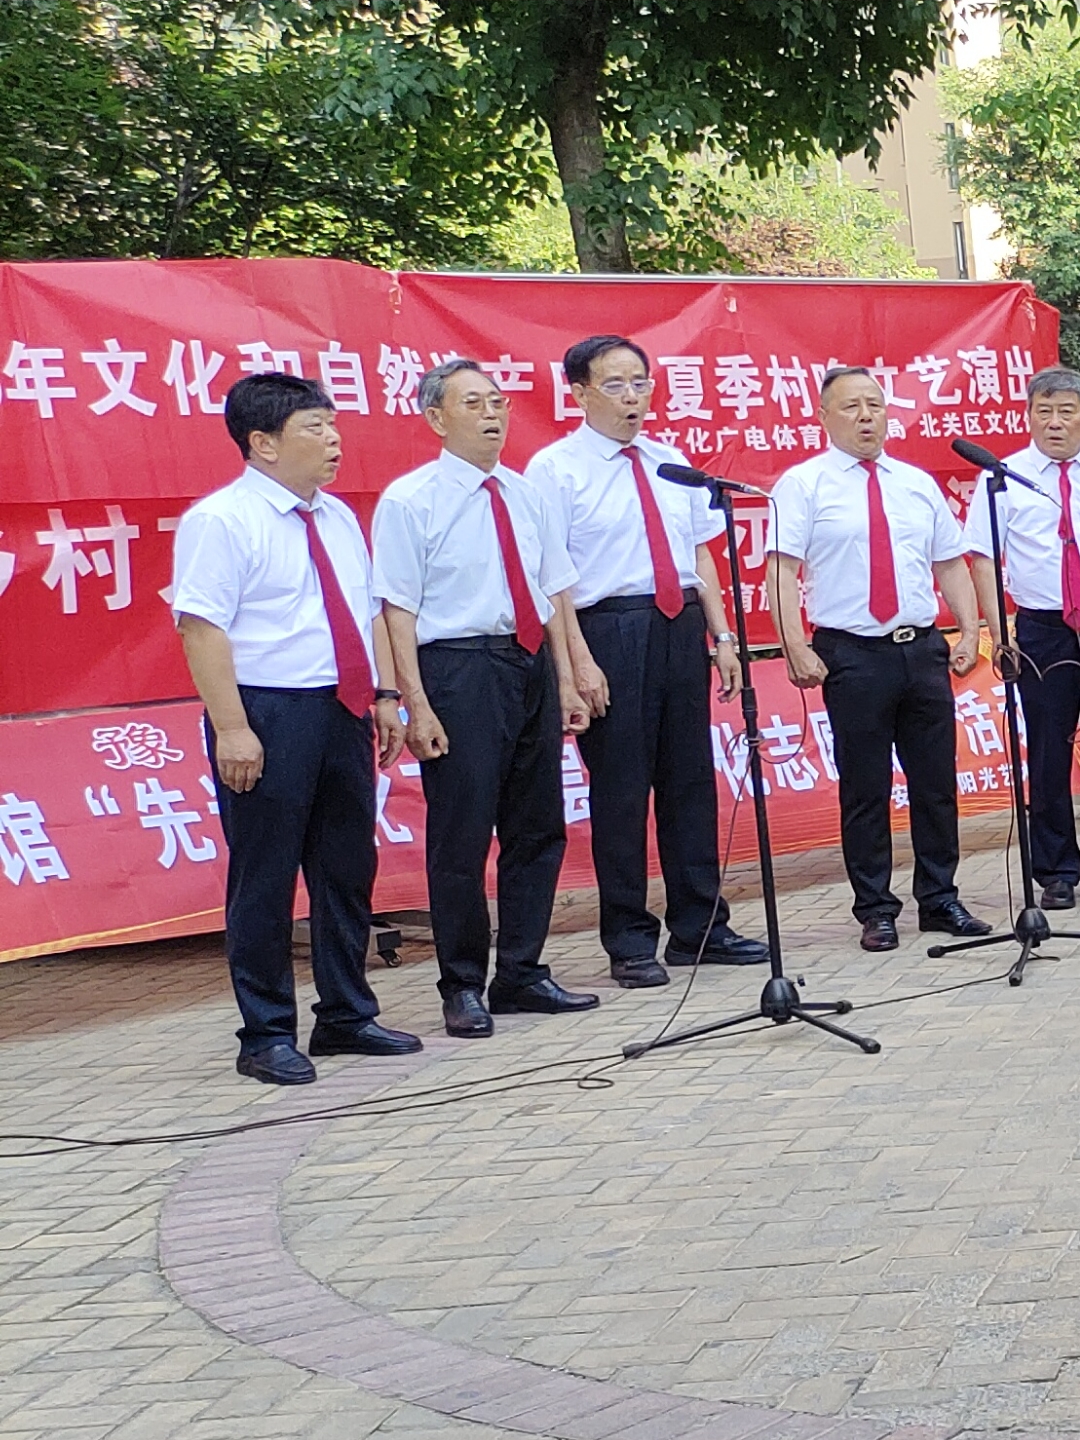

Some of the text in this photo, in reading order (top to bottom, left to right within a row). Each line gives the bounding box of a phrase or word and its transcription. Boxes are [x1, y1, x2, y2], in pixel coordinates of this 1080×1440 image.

[920, 408, 1032, 439] 北关区文化
